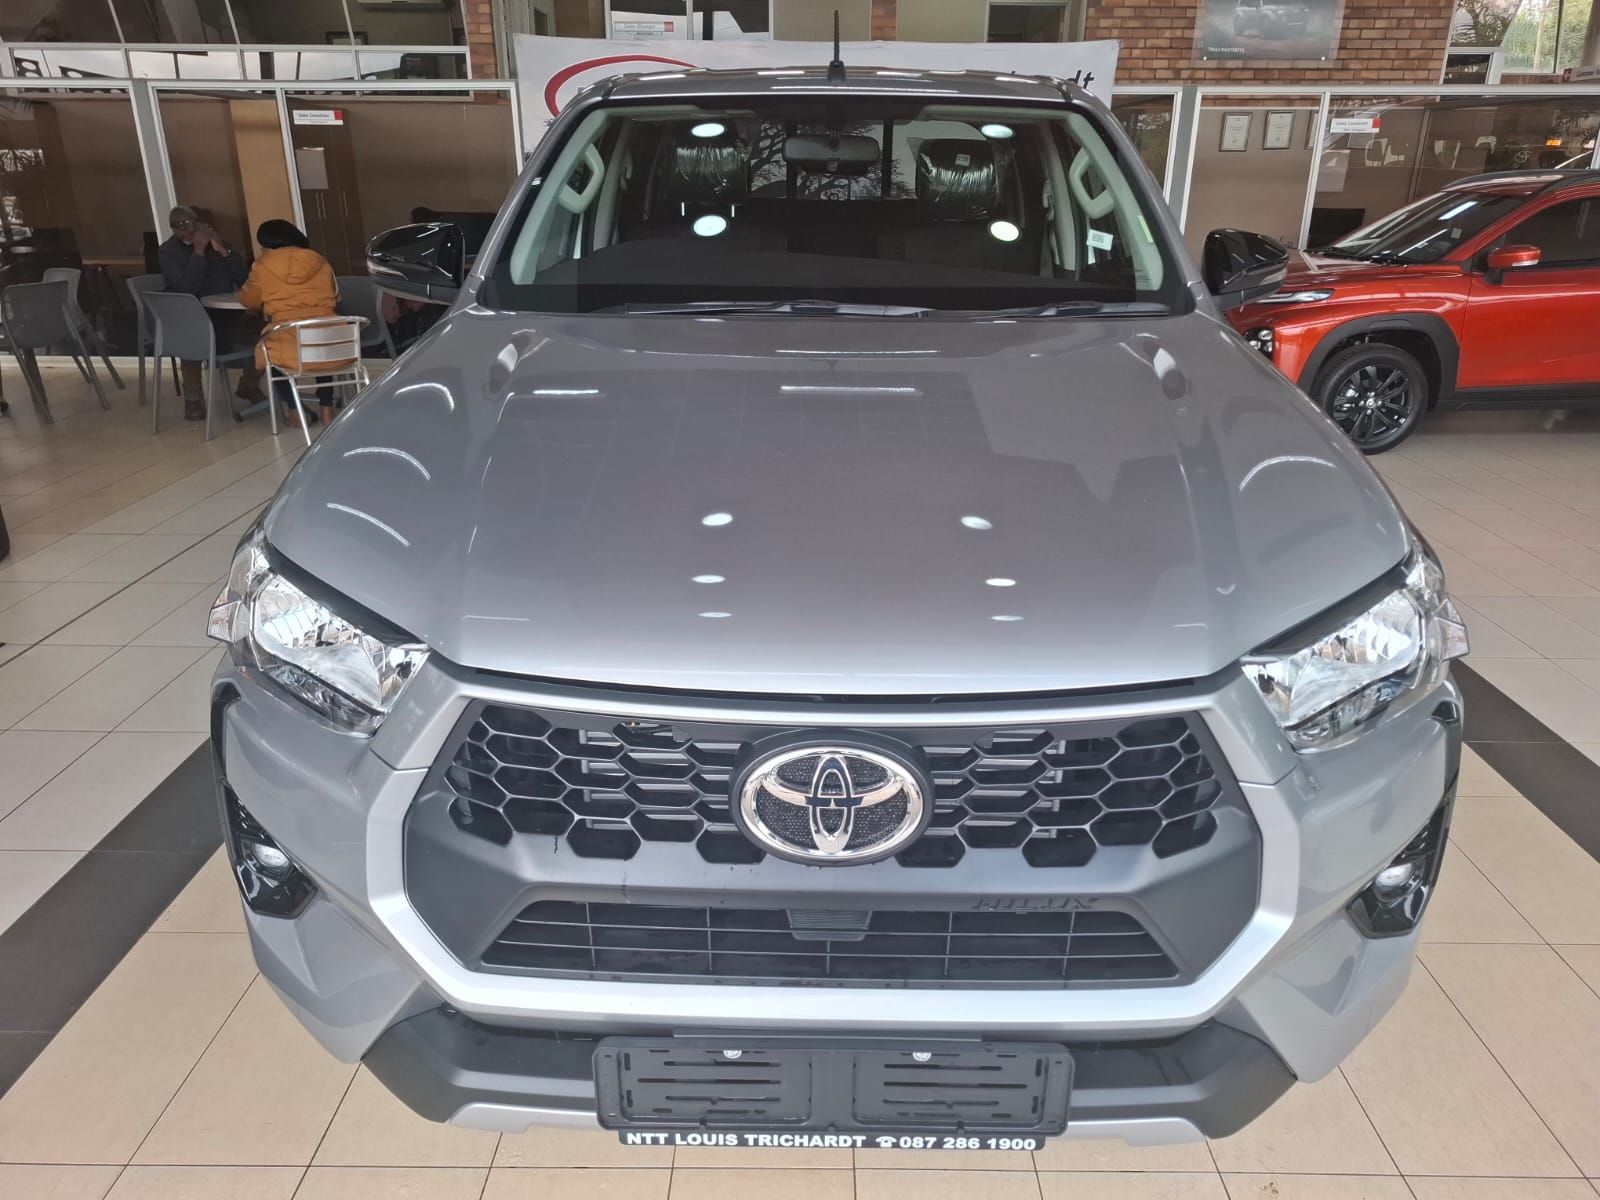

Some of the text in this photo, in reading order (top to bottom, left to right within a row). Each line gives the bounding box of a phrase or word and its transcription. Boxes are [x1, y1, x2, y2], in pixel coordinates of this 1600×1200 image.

[627, 1132, 1036, 1151] NTT LOUIS TRICHARDT 087 286 1900
